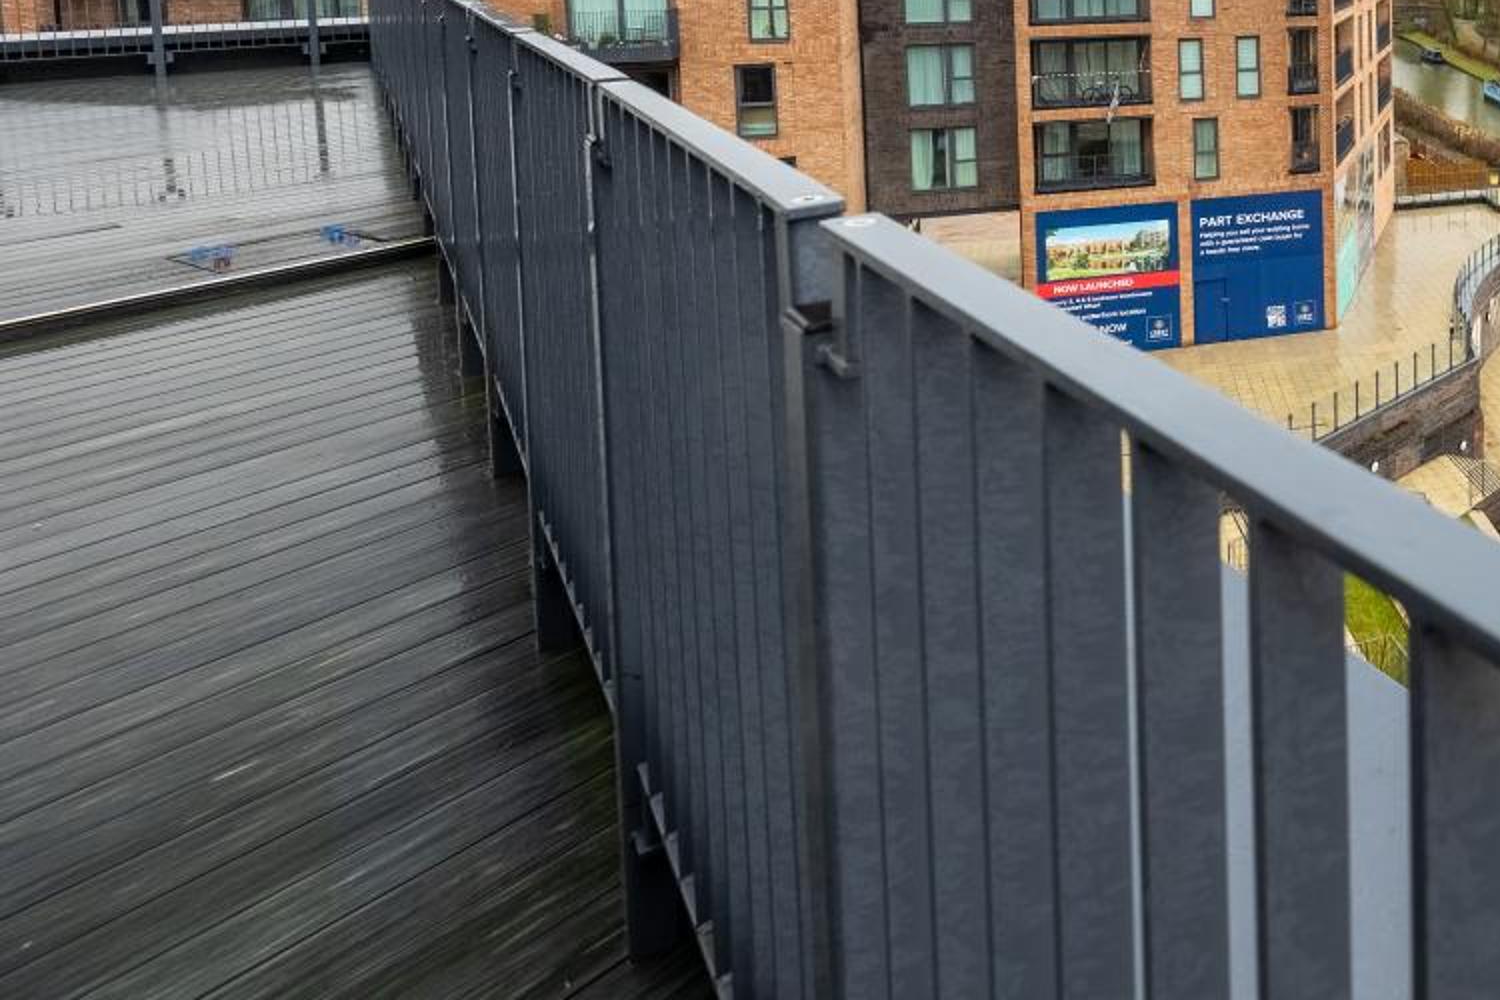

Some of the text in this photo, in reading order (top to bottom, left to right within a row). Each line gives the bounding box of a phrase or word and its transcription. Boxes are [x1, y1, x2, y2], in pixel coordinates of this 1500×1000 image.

[1200, 209, 1305, 227] PART EXCHANGE
[1053, 278, 1135, 295] NOW LAUNCHED
